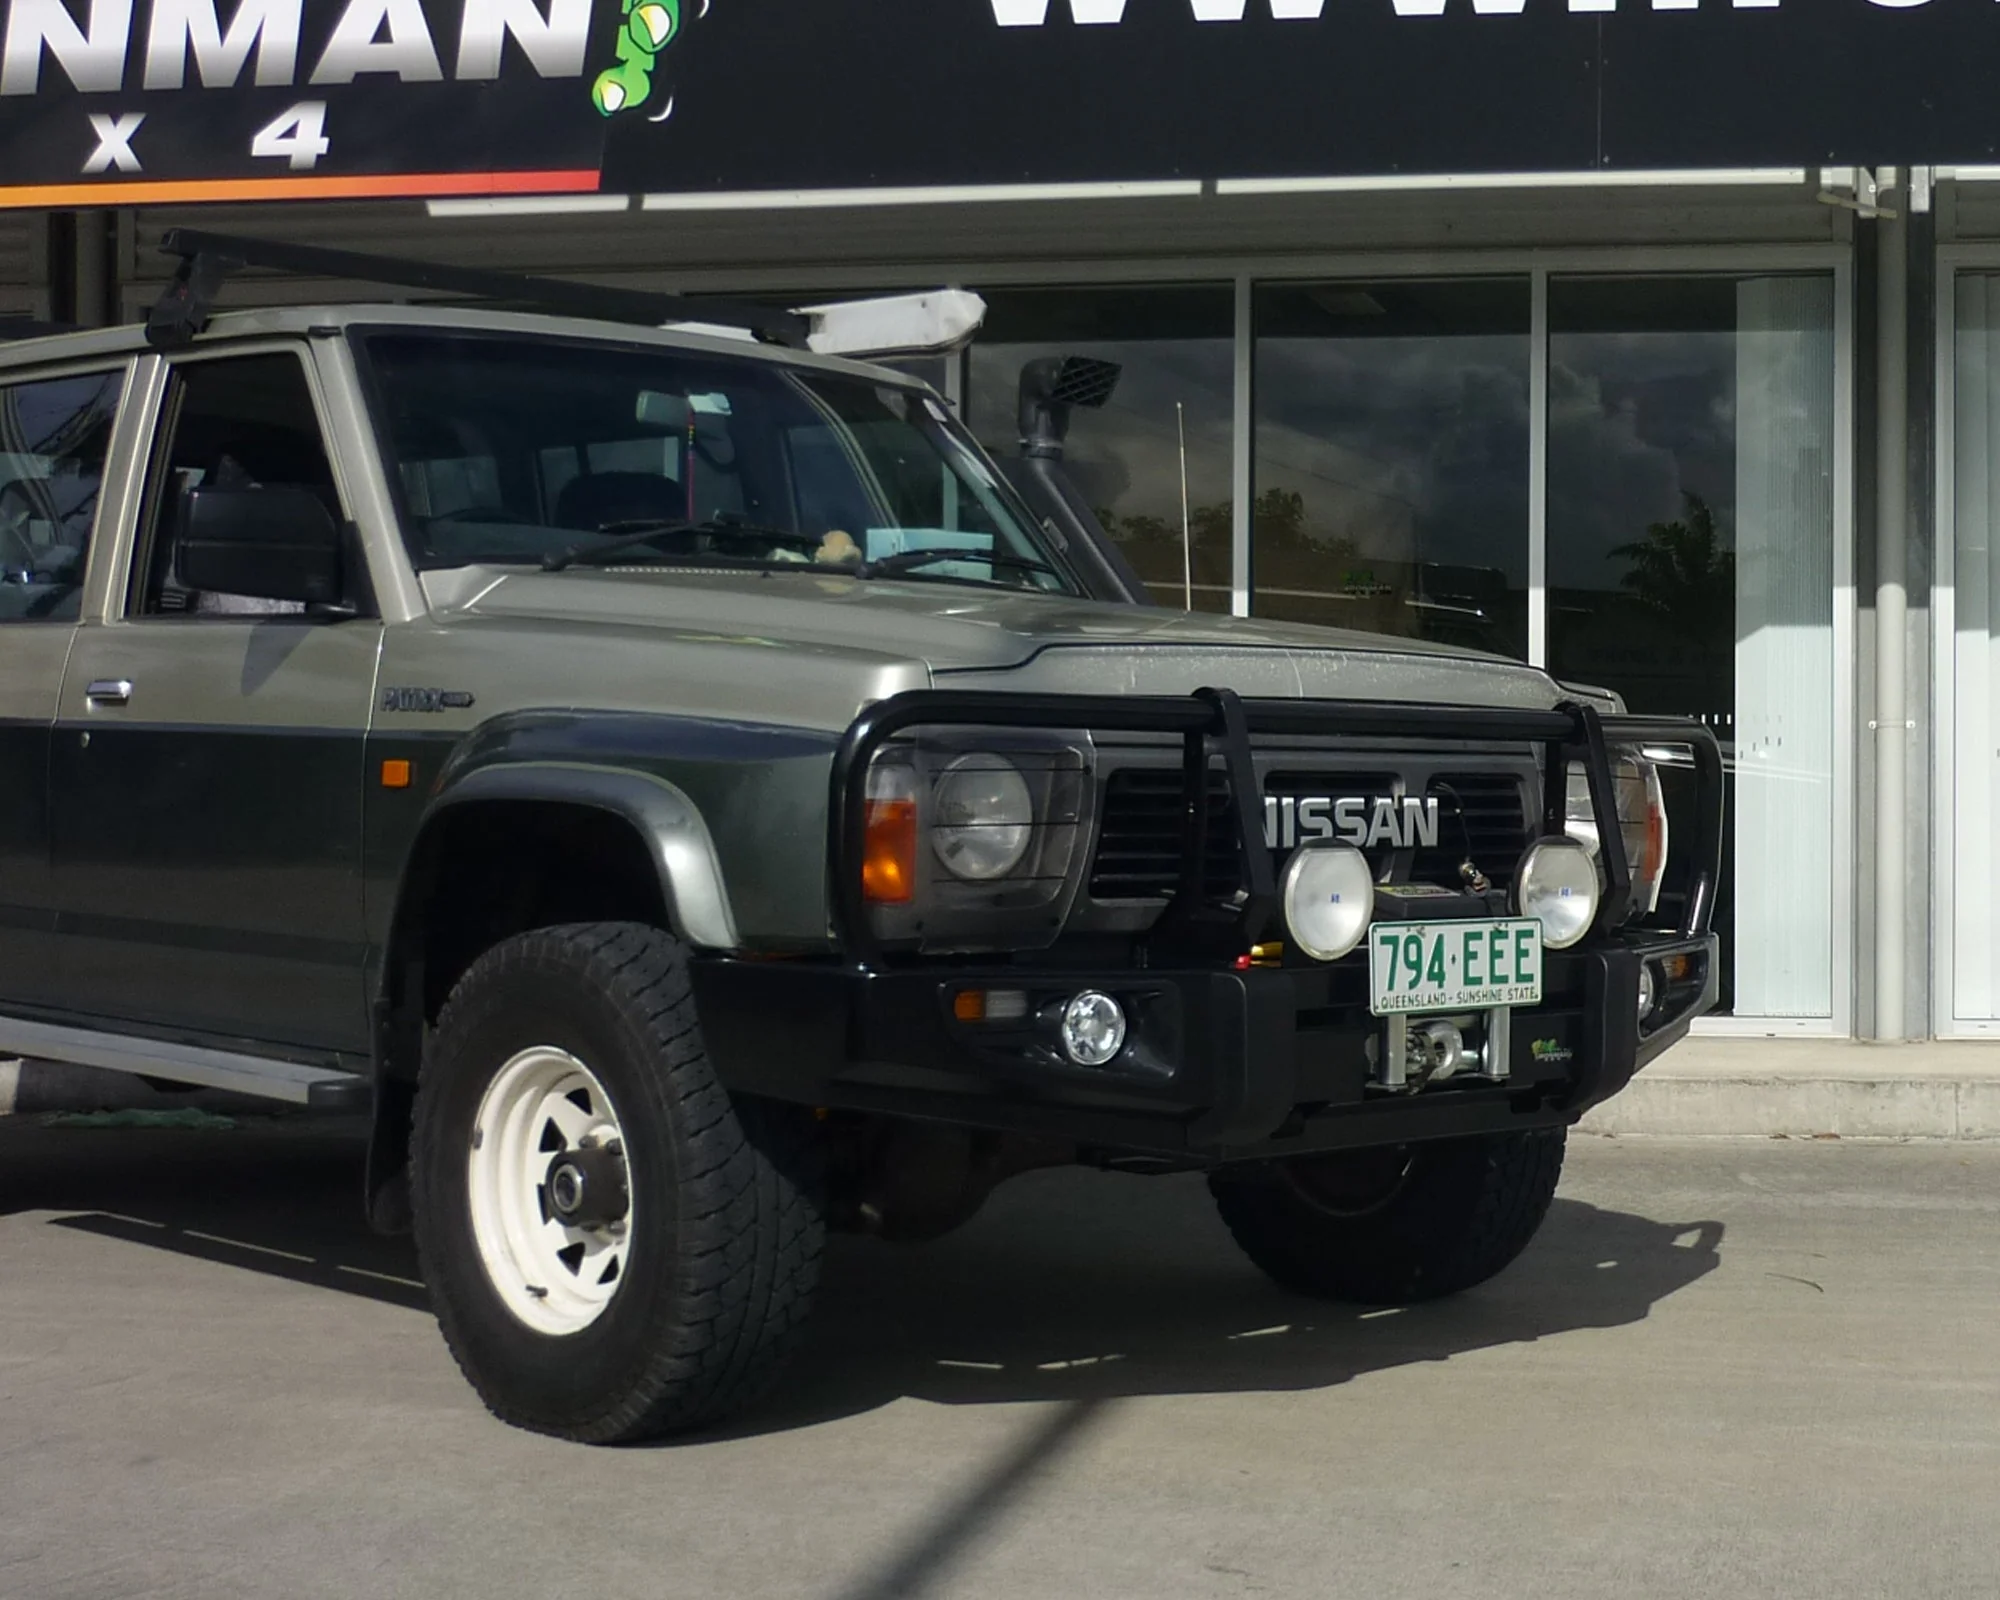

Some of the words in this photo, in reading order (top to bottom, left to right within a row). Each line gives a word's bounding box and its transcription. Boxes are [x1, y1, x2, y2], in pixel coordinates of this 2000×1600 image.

[251, 101, 329, 169] 4
[1381, 992, 1446, 1009] QUEENSLAND
[1457, 988, 1502, 1005] SUNSHINE
[1507, 986, 1534, 1001] STATE
